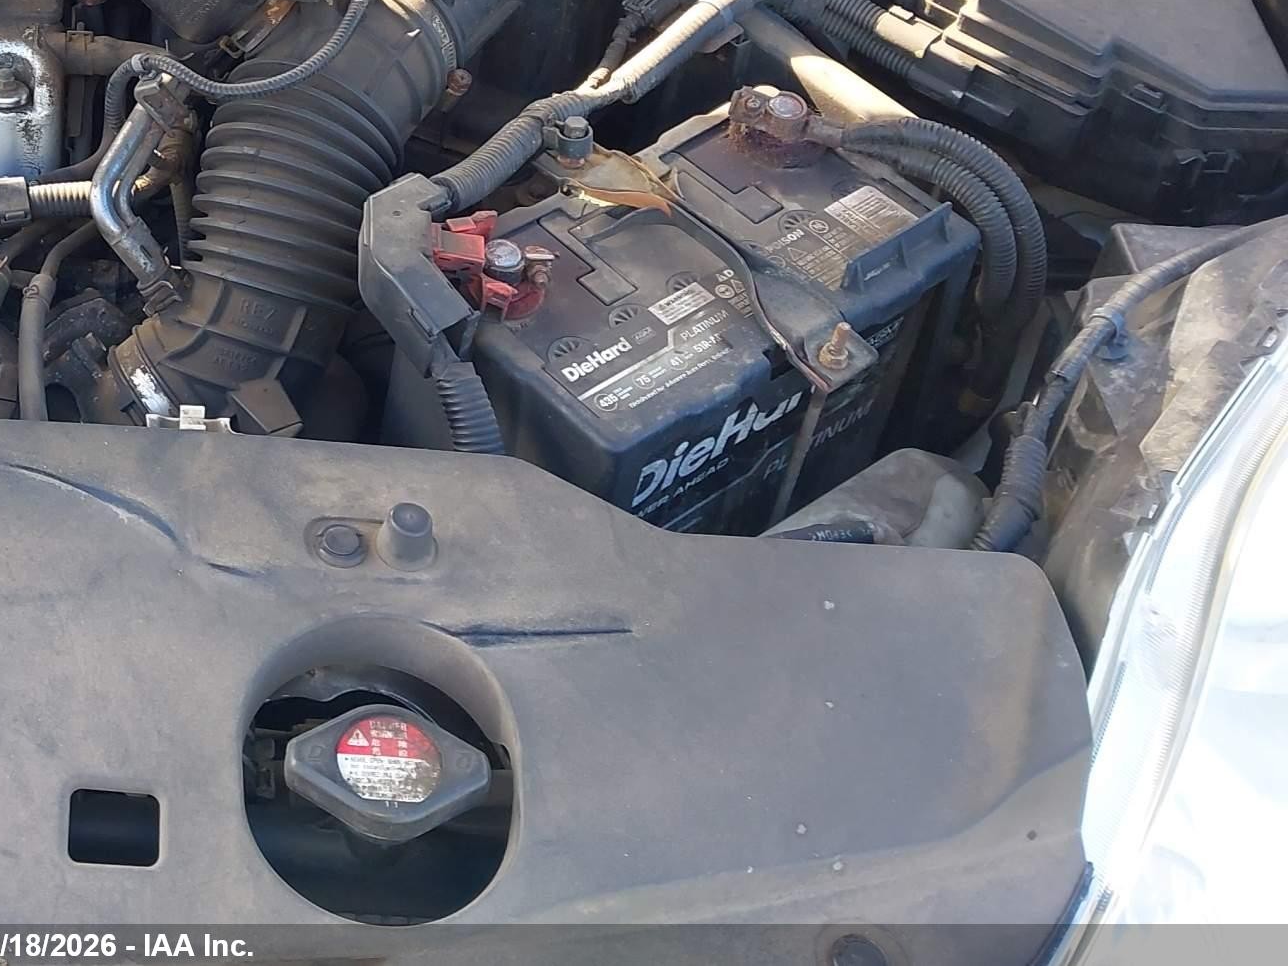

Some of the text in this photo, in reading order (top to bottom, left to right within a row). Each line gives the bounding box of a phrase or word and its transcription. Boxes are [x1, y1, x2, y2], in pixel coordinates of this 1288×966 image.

[680, 309, 730, 342] PLATINUM
[561, 337, 633, 383] DieHard
[598, 392, 618, 409] 435
